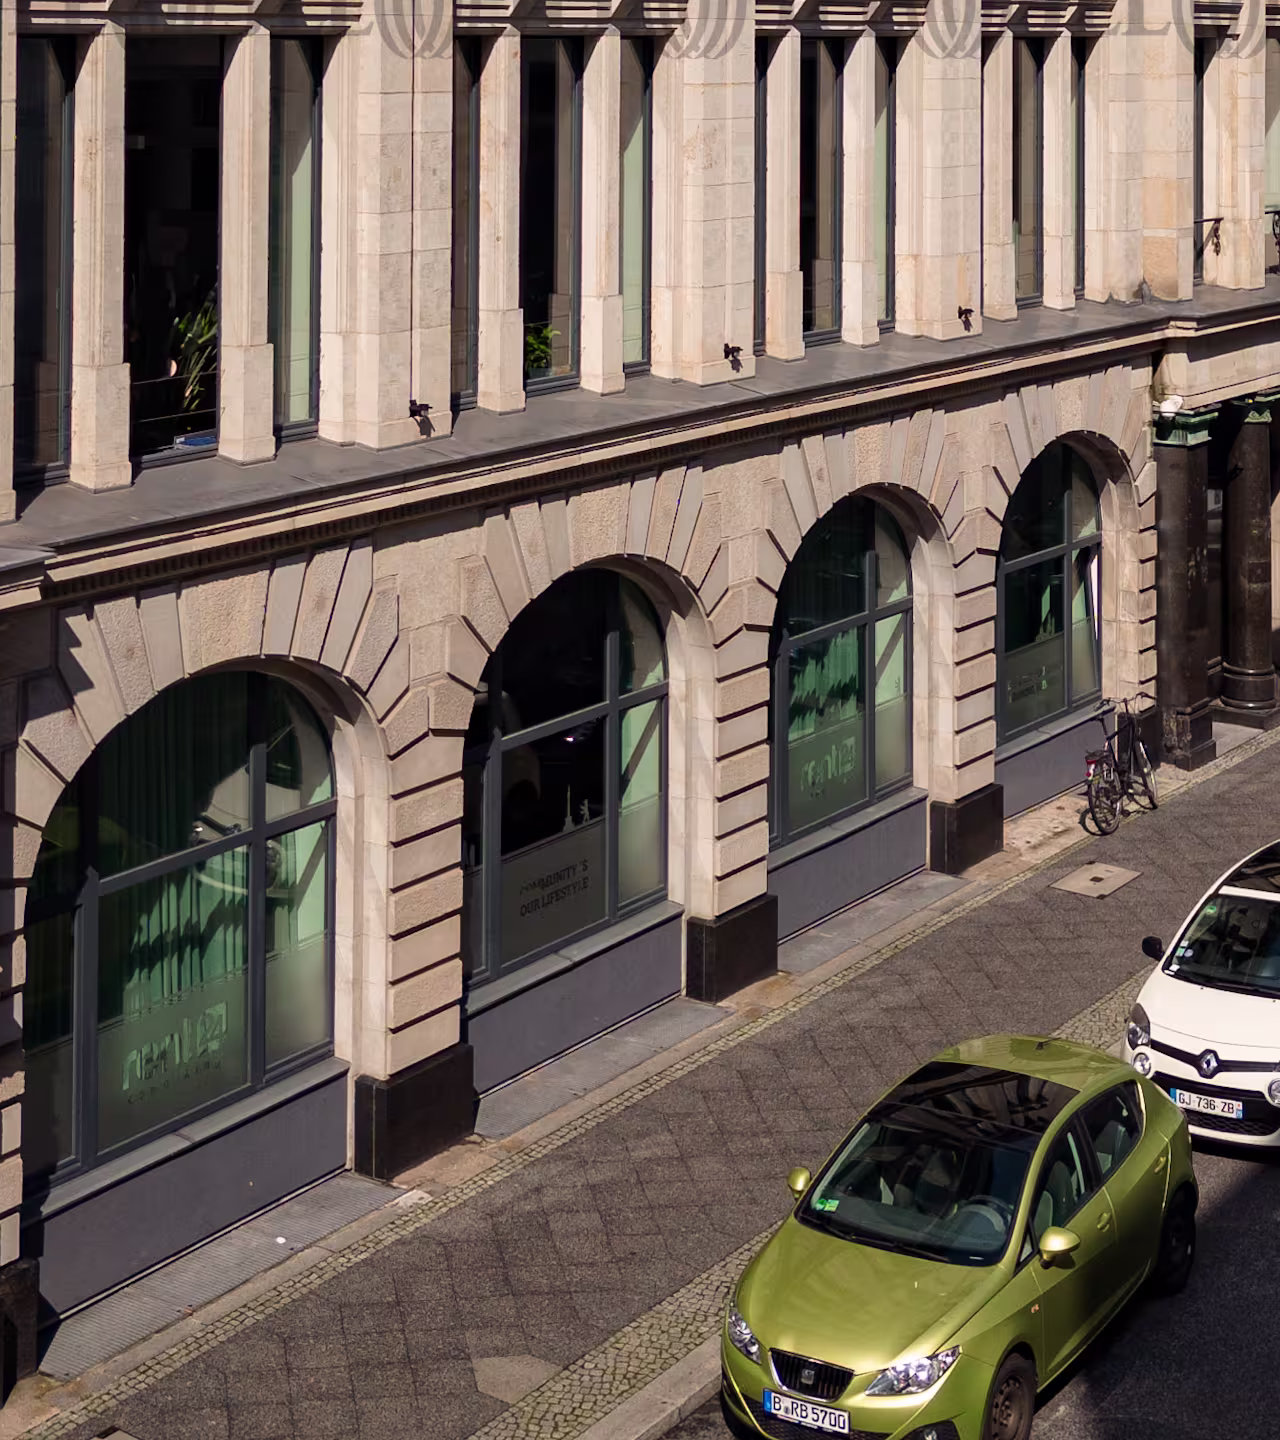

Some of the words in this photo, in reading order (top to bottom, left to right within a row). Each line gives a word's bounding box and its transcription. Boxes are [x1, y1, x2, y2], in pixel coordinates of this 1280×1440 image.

[773, 1396, 782, 1411] B
[791, 1401, 808, 1419] RB
[812, 1407, 846, 1430] 5700
